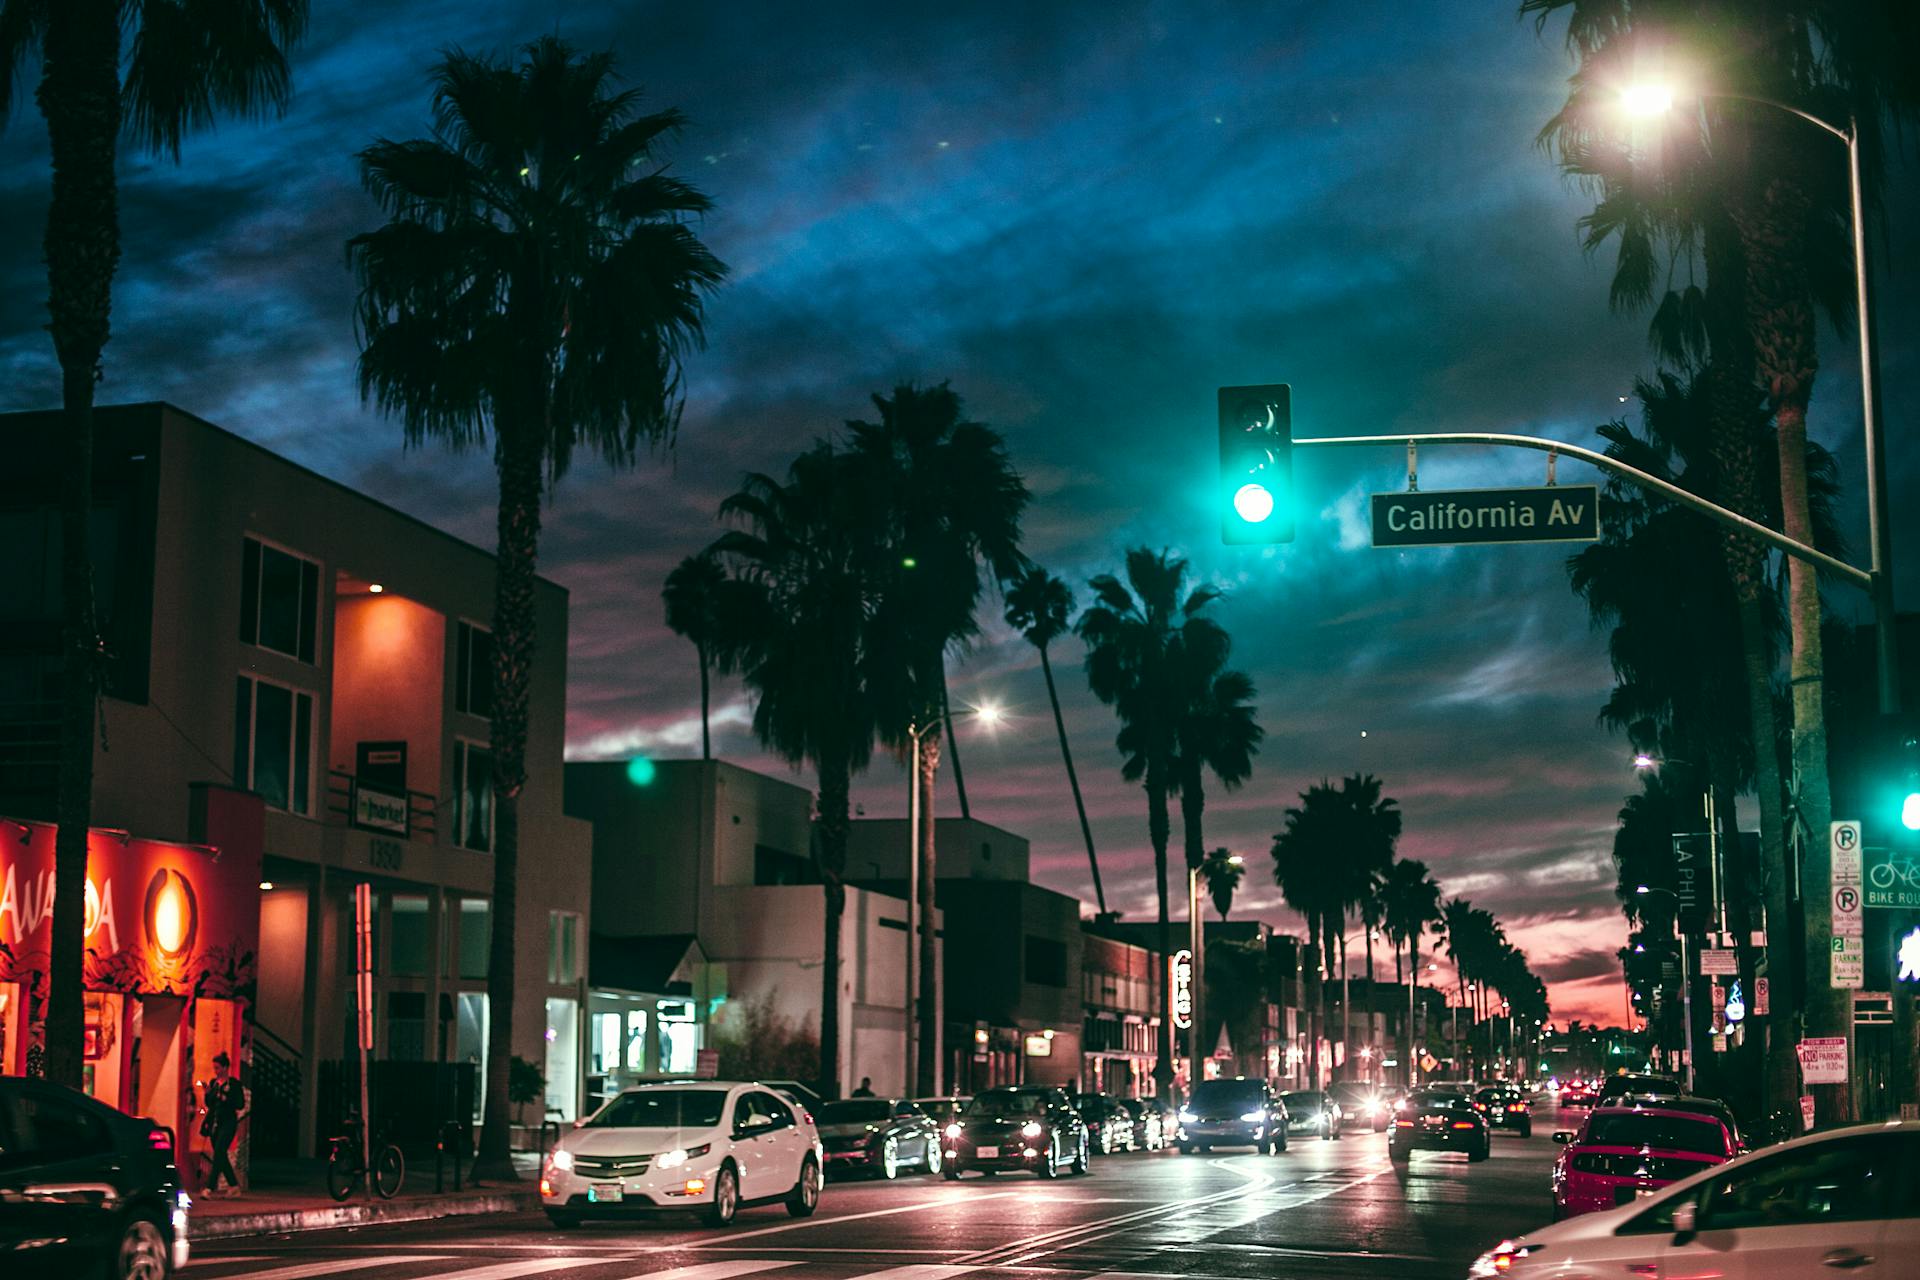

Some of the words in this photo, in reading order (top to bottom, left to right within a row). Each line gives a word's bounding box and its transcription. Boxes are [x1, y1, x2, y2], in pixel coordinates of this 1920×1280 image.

[1388, 501, 1535, 532] California
[1548, 499, 1584, 526] Av
[1678, 868, 1696, 912] PHIL
[1869, 891, 1894, 904] BIKE
[1834, 953, 1861, 963] PARKING
[1804, 1051, 1817, 1061] NO
[1819, 1052, 1844, 1061] PARKING
